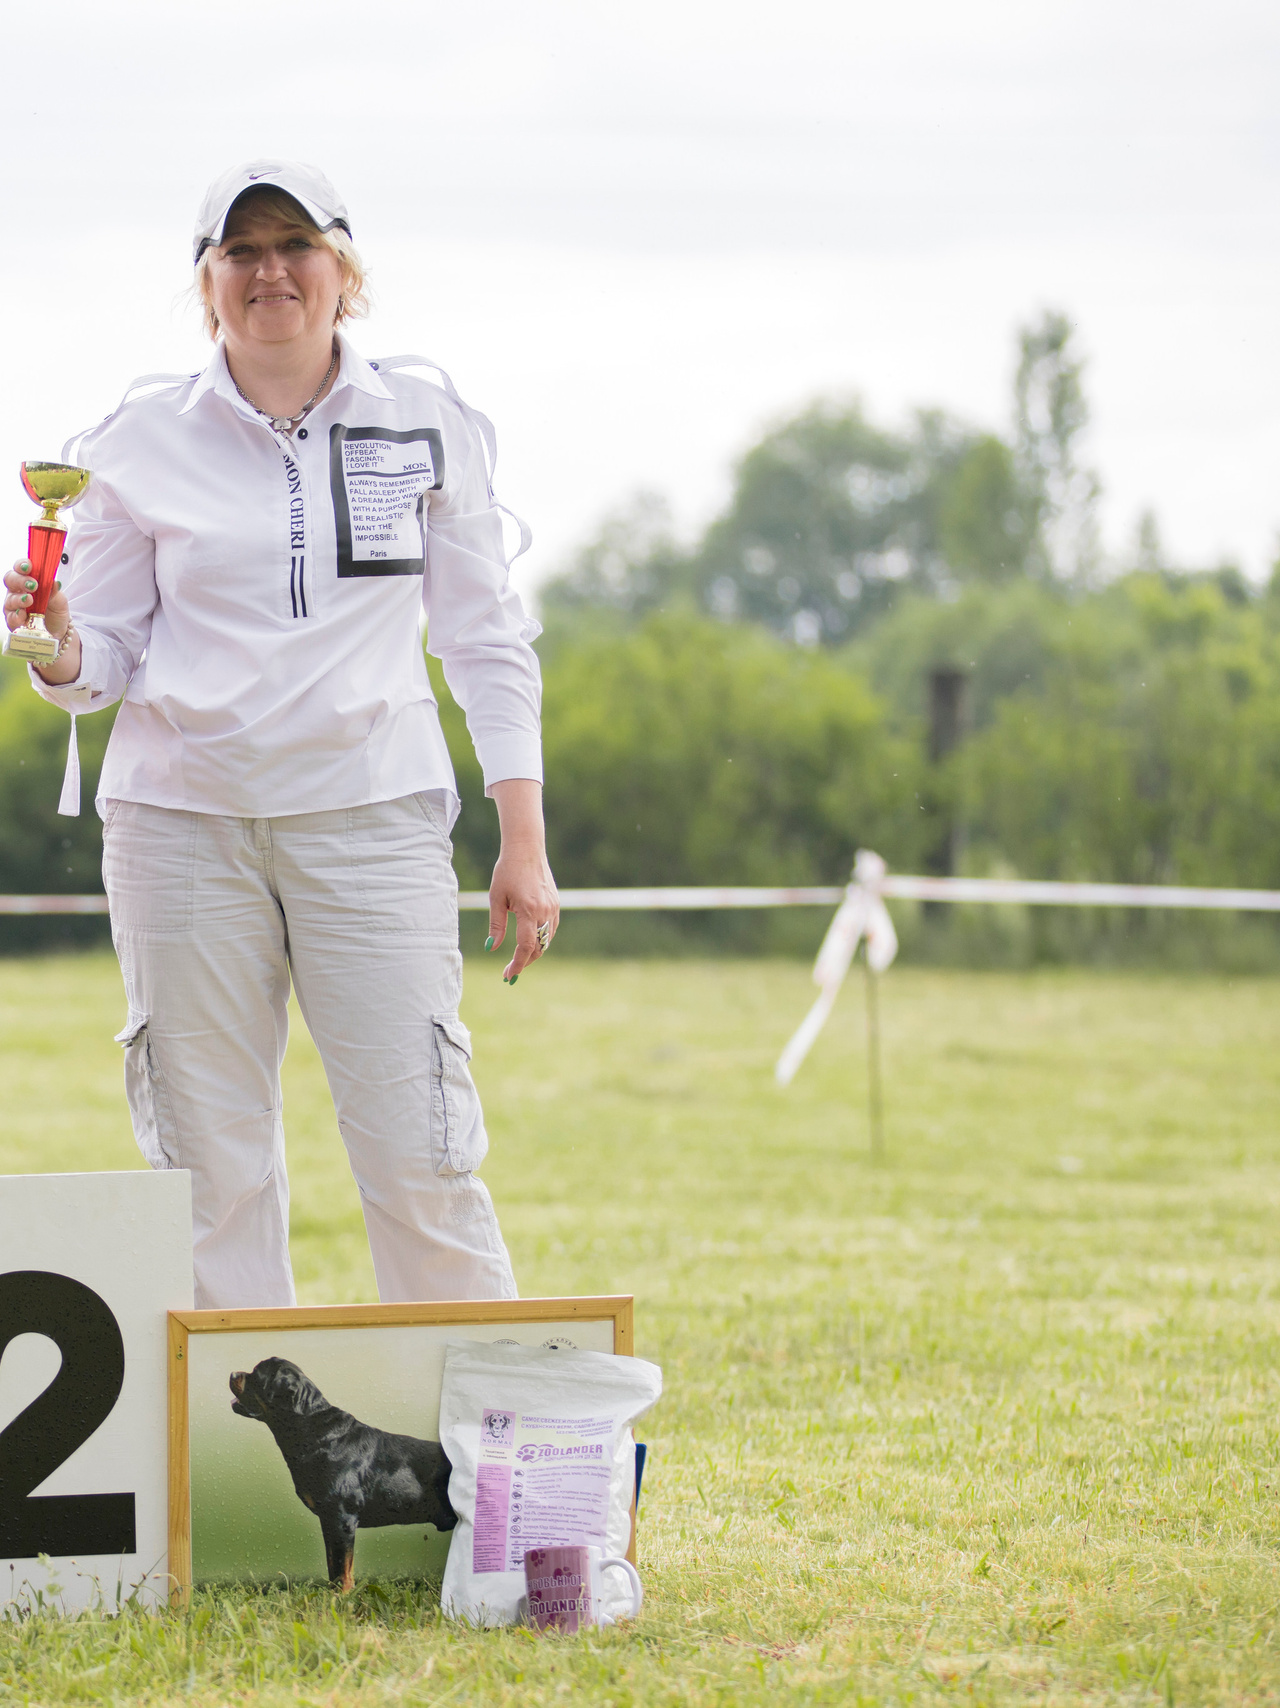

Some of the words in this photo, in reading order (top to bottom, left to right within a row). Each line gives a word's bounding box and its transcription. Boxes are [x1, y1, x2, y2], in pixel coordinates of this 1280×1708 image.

[344, 442, 392, 451] REVOLUTION
[403, 462, 427, 471] MON
[283, 454, 302, 494] MON
[379, 477, 421, 488] REMEMBER
[397, 486, 417, 494] WITH
[384, 496, 401, 504] AND
[378, 502, 412, 513] PURPOSE
[365, 512, 405, 521] REALISTIC
[290, 497, 305, 551] CHERI
[355, 533, 399, 541] IMPOSSIBLE
[538, 1444, 603, 1457] ZOOLANDER
